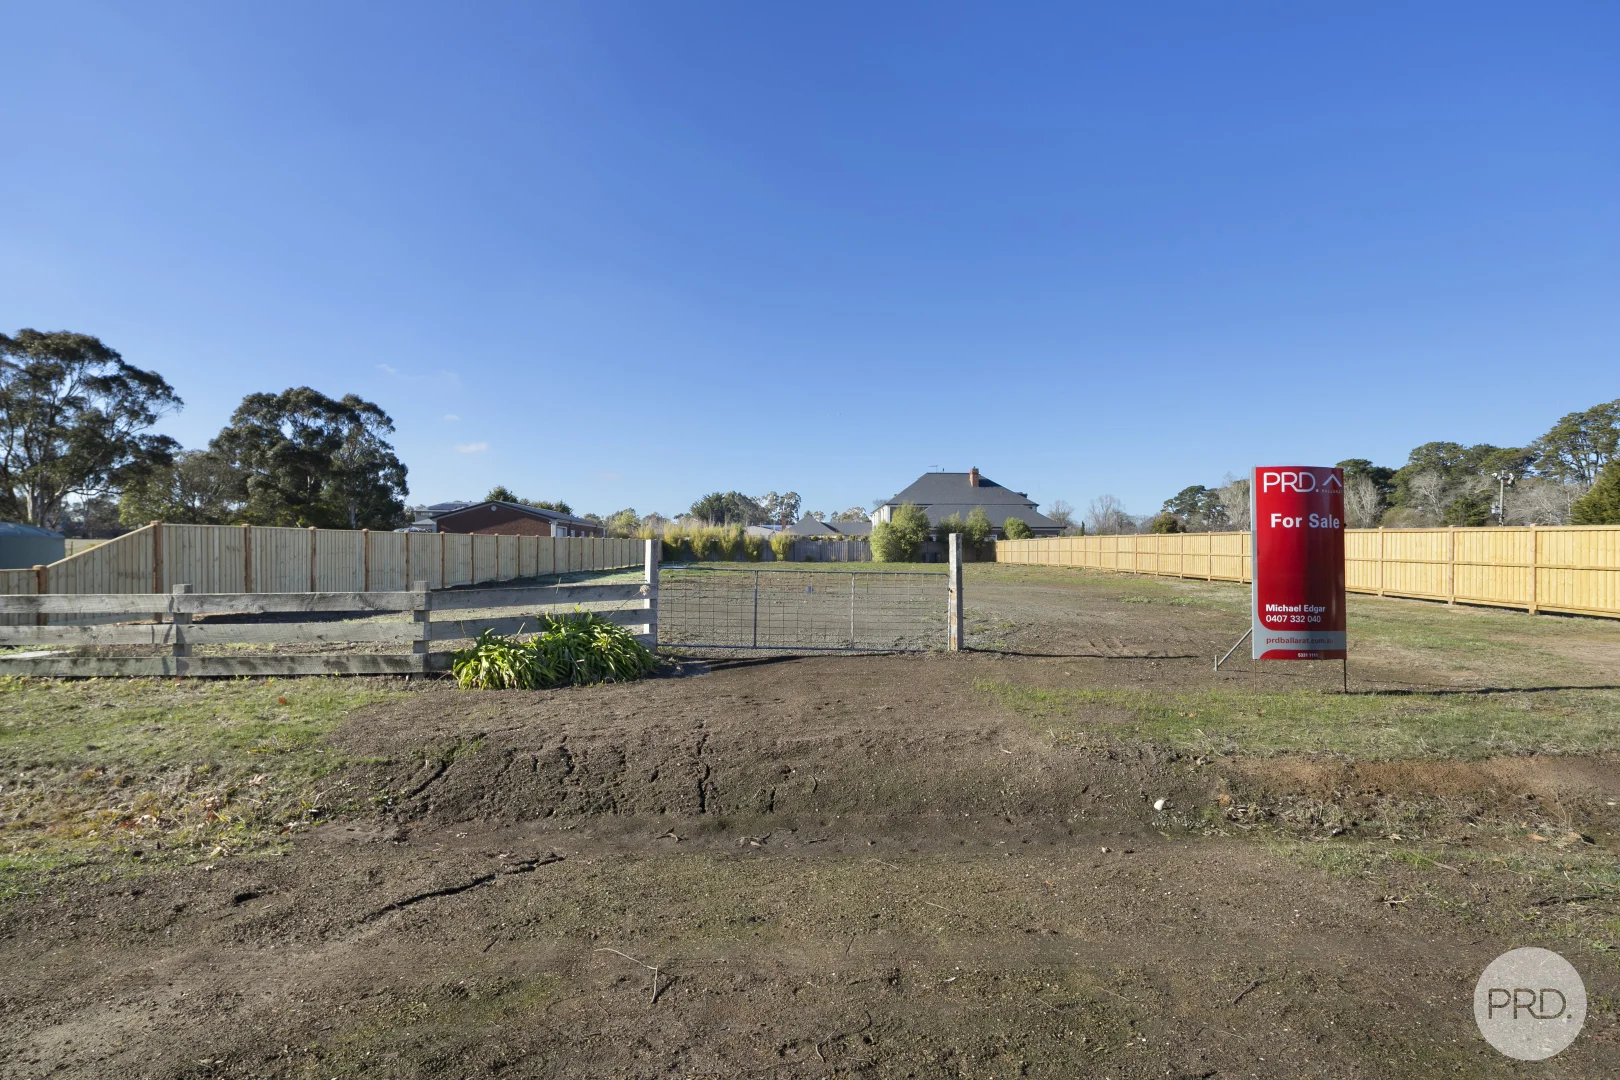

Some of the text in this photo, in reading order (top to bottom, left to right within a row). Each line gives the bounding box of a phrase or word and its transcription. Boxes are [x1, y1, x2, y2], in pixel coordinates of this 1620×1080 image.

[1270, 513, 1340, 529] For Sale
[1265, 604, 1326, 613] Michael Edgar
[1265, 614, 1321, 623] 0407 332 040
[1266, 637, 1334, 645] prdballarat.com.au
